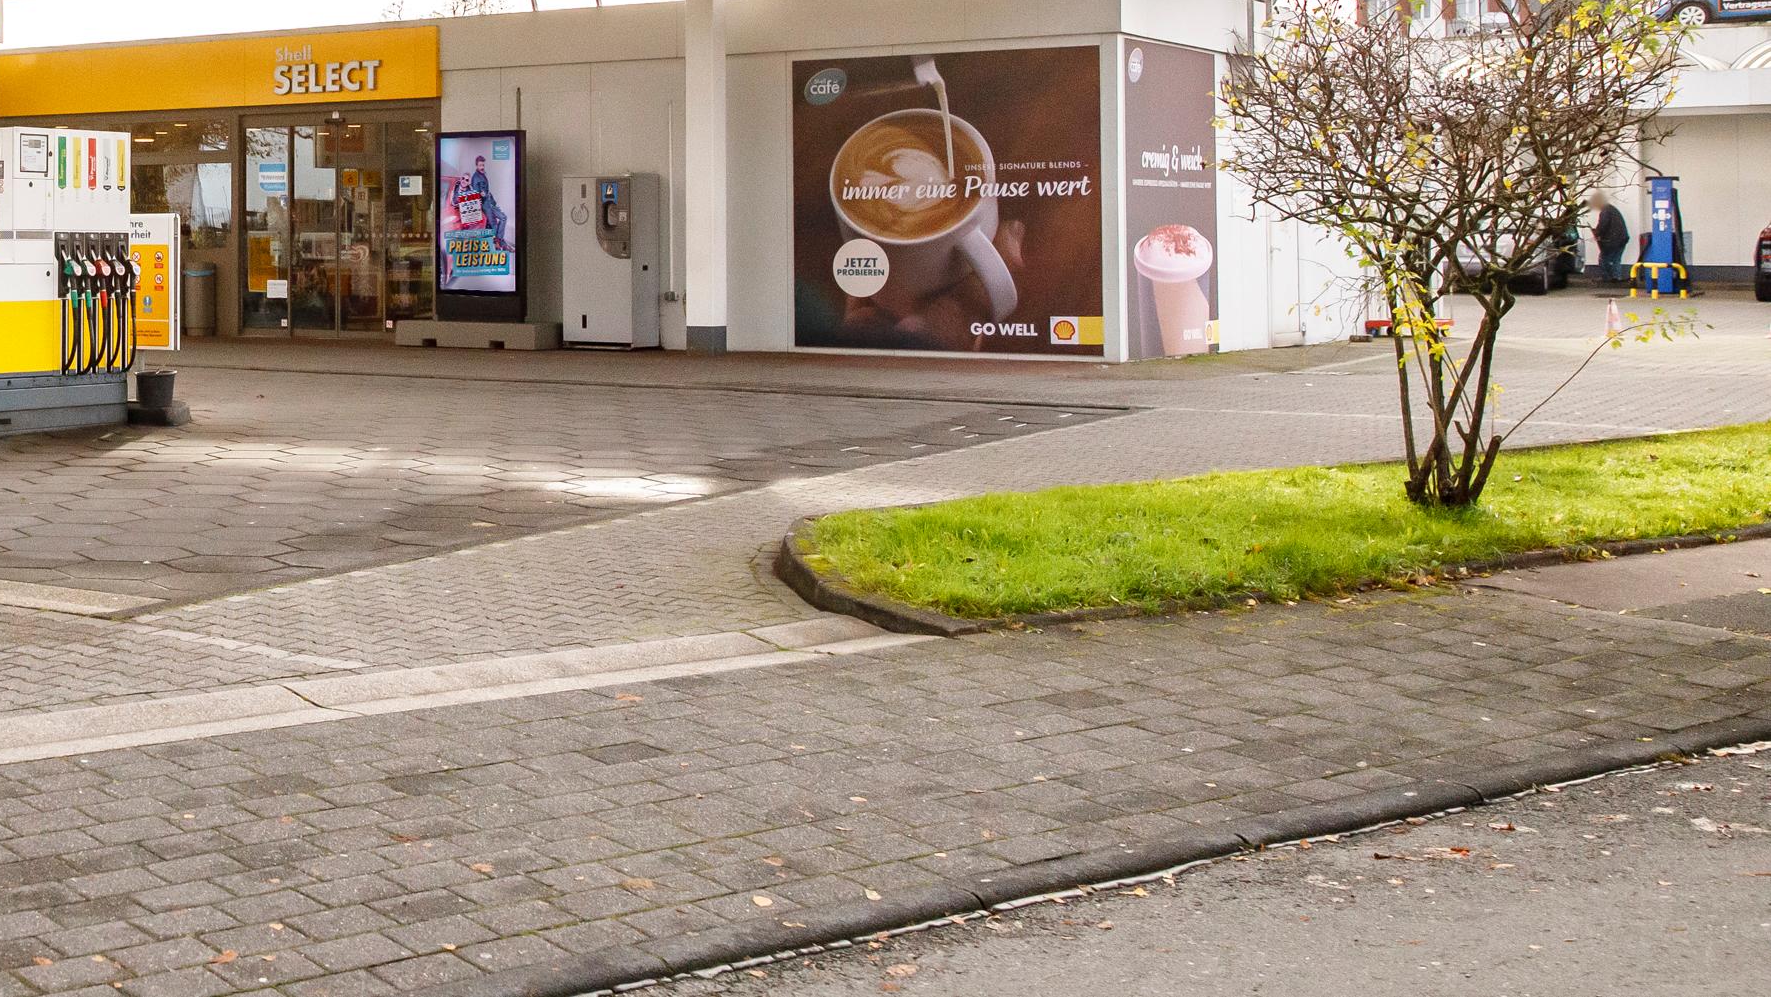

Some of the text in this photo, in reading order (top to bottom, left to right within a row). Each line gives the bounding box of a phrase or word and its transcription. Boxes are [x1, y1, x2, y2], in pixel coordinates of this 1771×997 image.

[275, 44, 312, 62] Shell
[274, 60, 381, 95] SELECT
[999, 162, 1046, 171] SIGNATURE
[1049, 161, 1082, 169] BLENDS
[1142, 145, 1169, 177] cremig
[1171, 145, 1179, 173] &
[842, 175, 1092, 201] immer eine Pause wert
[130, 229, 151, 239] rheit
[449, 239, 490, 253] PREIS &
[456, 252, 507, 267] LEISTUNG
[843, 257, 878, 268] JETZT
[836, 269, 885, 277] PROBIEREN
[970, 322, 1038, 337] GO WELL
